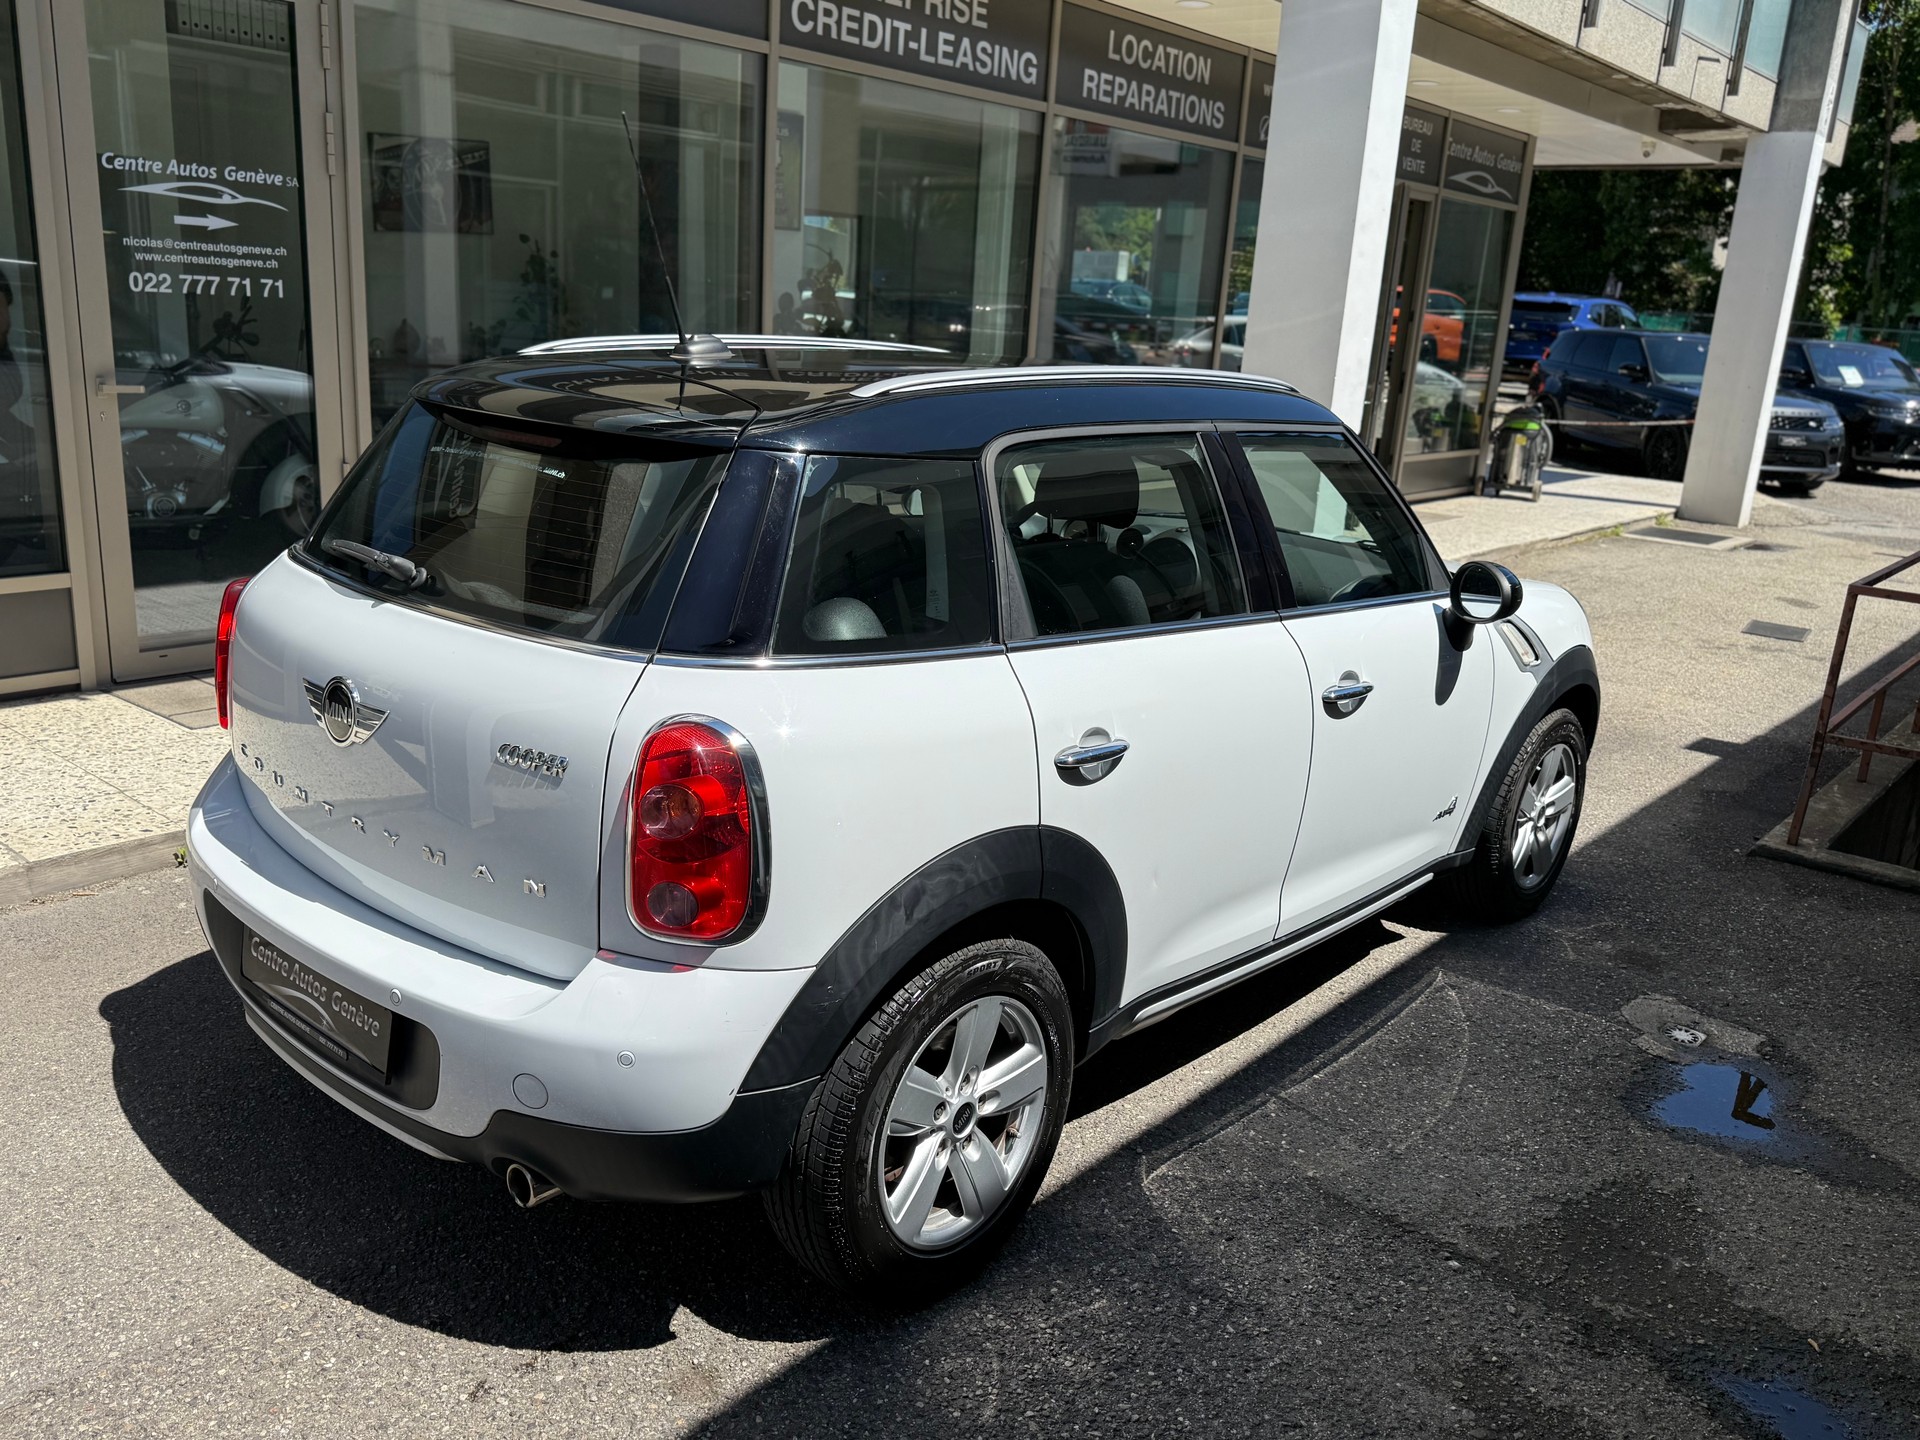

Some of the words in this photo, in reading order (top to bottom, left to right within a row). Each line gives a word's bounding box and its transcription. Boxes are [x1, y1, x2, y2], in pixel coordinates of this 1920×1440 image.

[876, 0, 989, 29] RISE
[791, 0, 1038, 85] CREDIT-LEASING
[1108, 29, 1212, 85] LOCATION
[1082, 68, 1225, 129] REPARATIONS
[1403, 115, 1433, 136] BUREAU
[1411, 138, 1422, 153] DE
[1472, 145, 1495, 168] Autos
[101, 152, 163, 174] Centre
[166, 159, 218, 179] Autos
[224, 166, 284, 187] Genève
[286, 176, 300, 188] SA
[1402, 156, 1426, 174] VENTE
[123, 236, 288, 257] nicolas@centreautosgeneve.ch
[134, 252, 279, 270] www.centreautosgeneve.ch
[128, 272, 173, 294] 022
[179, 274, 221, 296] 777
[227, 277, 252, 297] 71
[260, 279, 285, 299] 71
[325, 700, 352, 726] MINI
[496, 742, 570, 779] COOPER
[240, 743, 547, 898] COUNTRYMAN
[966, 960, 999, 978] SPORT
[250, 936, 290, 977] Centre
[290, 963, 328, 1002] Autos
[331, 991, 381, 1037] Genève
[955, 1107, 972, 1132] MINI
